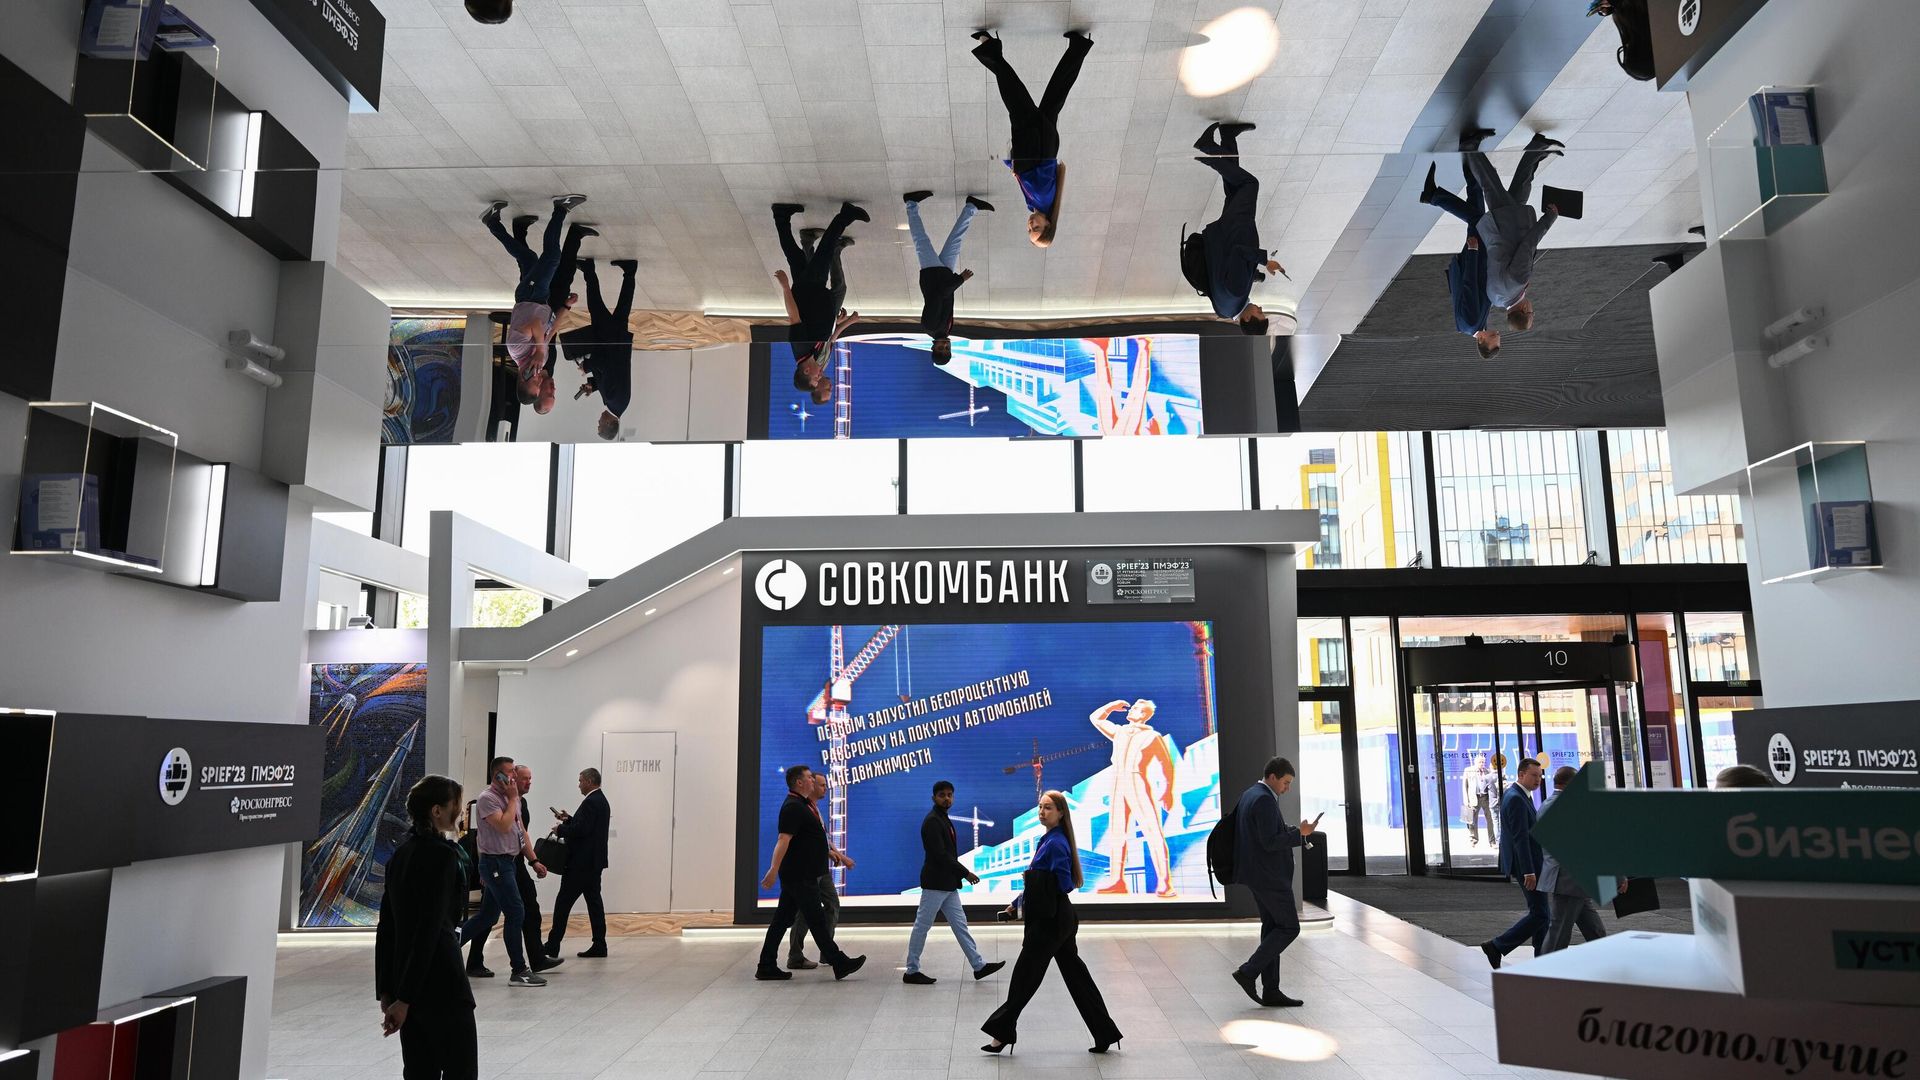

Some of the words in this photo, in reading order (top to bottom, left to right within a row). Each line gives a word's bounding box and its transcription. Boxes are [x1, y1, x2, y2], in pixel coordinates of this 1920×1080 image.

[1116, 562, 1150, 570] SPIEF'23
[1153, 561, 1190, 570] ПМЭФ'23
[819, 559, 1070, 607] СОВКОМБАНК
[1544, 650, 1568, 666] 10
[817, 715, 866, 742] ПЕРВЫМ
[868, 699, 928, 730] ЗАПУСТИЛ
[929, 669, 1030, 712] БЕСПРОЦЕНТНУЮ
[821, 732, 888, 765] РАССРОЧКУ
[890, 729, 907, 748] НА
[908, 714, 962, 743] ПОКУПКУ
[965, 687, 1052, 728] АВТОМОБИЛЕЙ
[200, 765, 246, 784] SPIEF'23
[251, 764, 295, 782] ПМЭФ'23
[836, 748, 933, 786] НЕДВИЖИМОСТИ
[1803, 749, 1851, 767] SPIEF'23
[1857, 749, 1918, 768] ПМЭФ'23
[240, 796, 293, 811] РОСКОНГРЕСС
[1726, 812, 1920, 861] бизне
[1847, 938, 1920, 969] уст
[1577, 1007, 1909, 1080] благополучие
